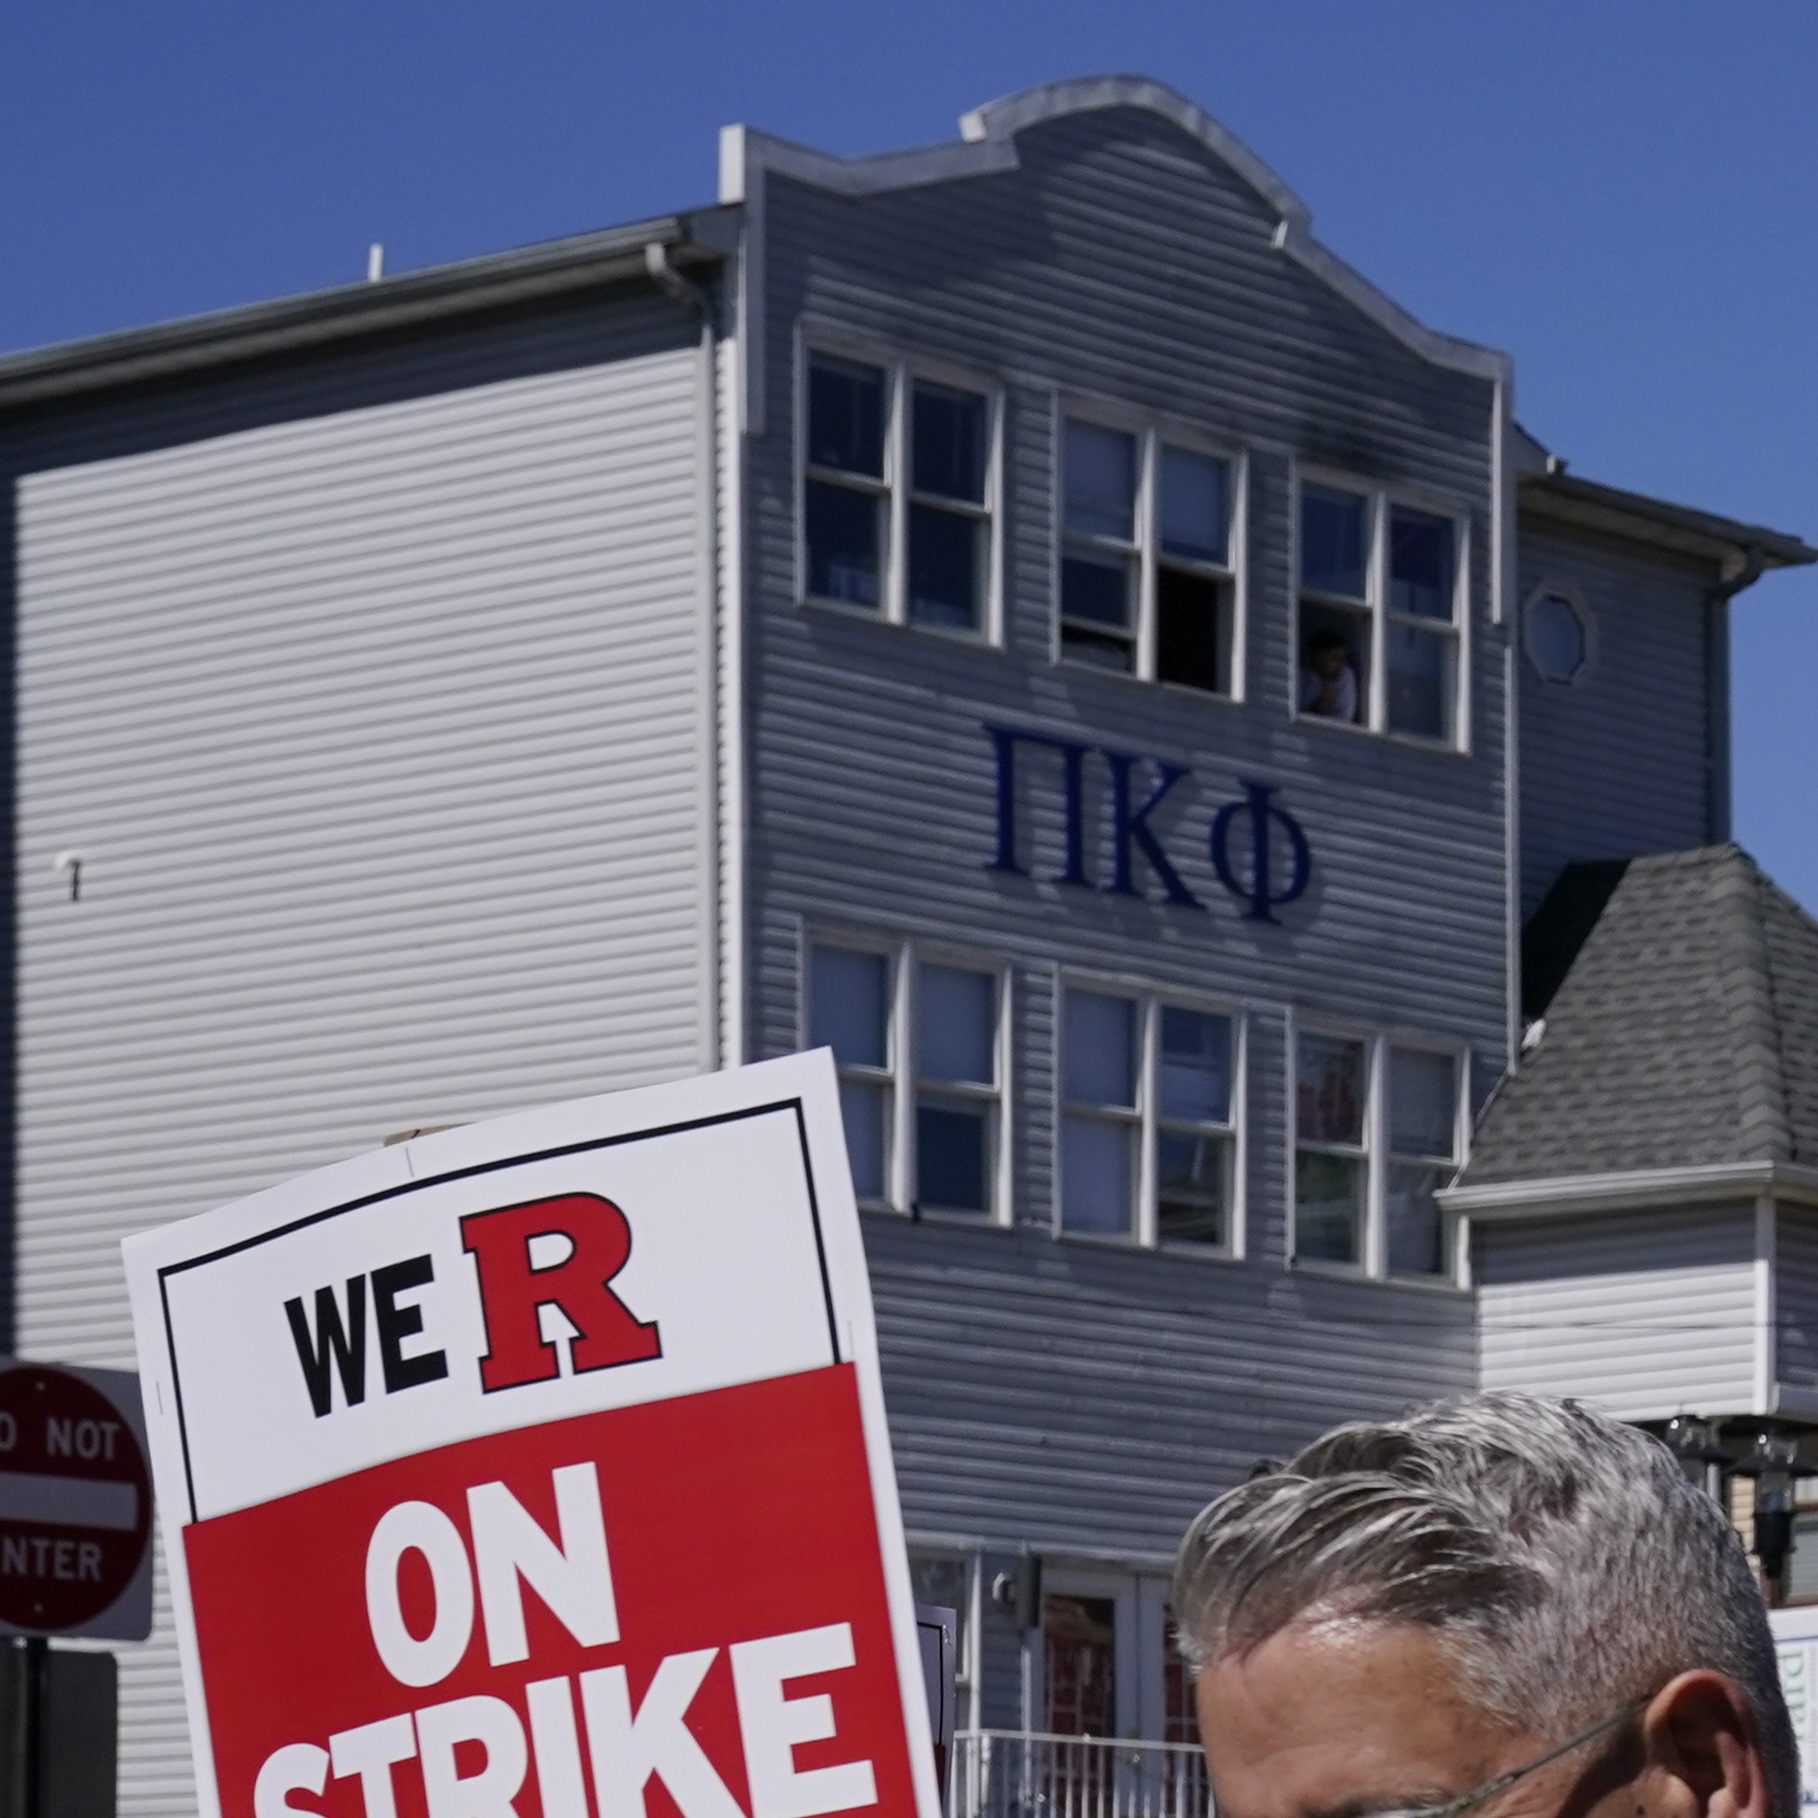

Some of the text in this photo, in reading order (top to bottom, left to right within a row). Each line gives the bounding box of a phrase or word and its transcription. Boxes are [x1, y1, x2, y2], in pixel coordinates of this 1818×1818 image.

[285, 1193, 662, 1417] WE R
[0, 1411, 120, 1462] O NOT
[0, 1534, 103, 1582] NTER
[365, 1461, 621, 1689] ON
